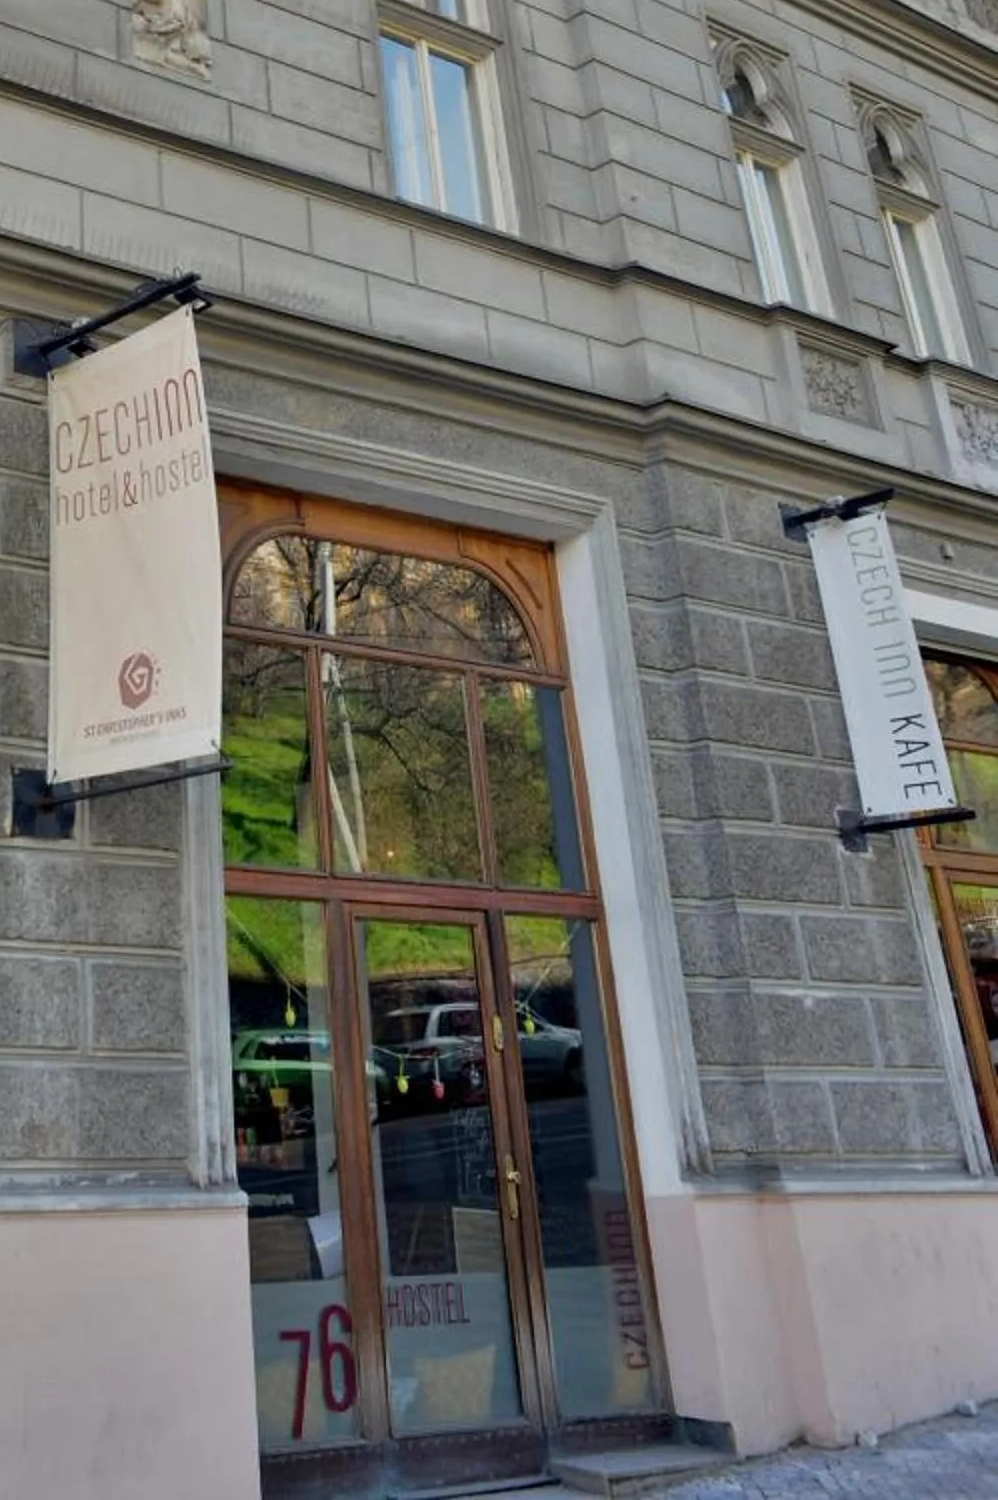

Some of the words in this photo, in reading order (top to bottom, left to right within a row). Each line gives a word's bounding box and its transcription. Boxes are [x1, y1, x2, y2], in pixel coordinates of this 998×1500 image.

[890, 713, 943, 800] KAFE
[387, 1283, 470, 1328] HOSTEL
[279, 1304, 358, 1440] 76
